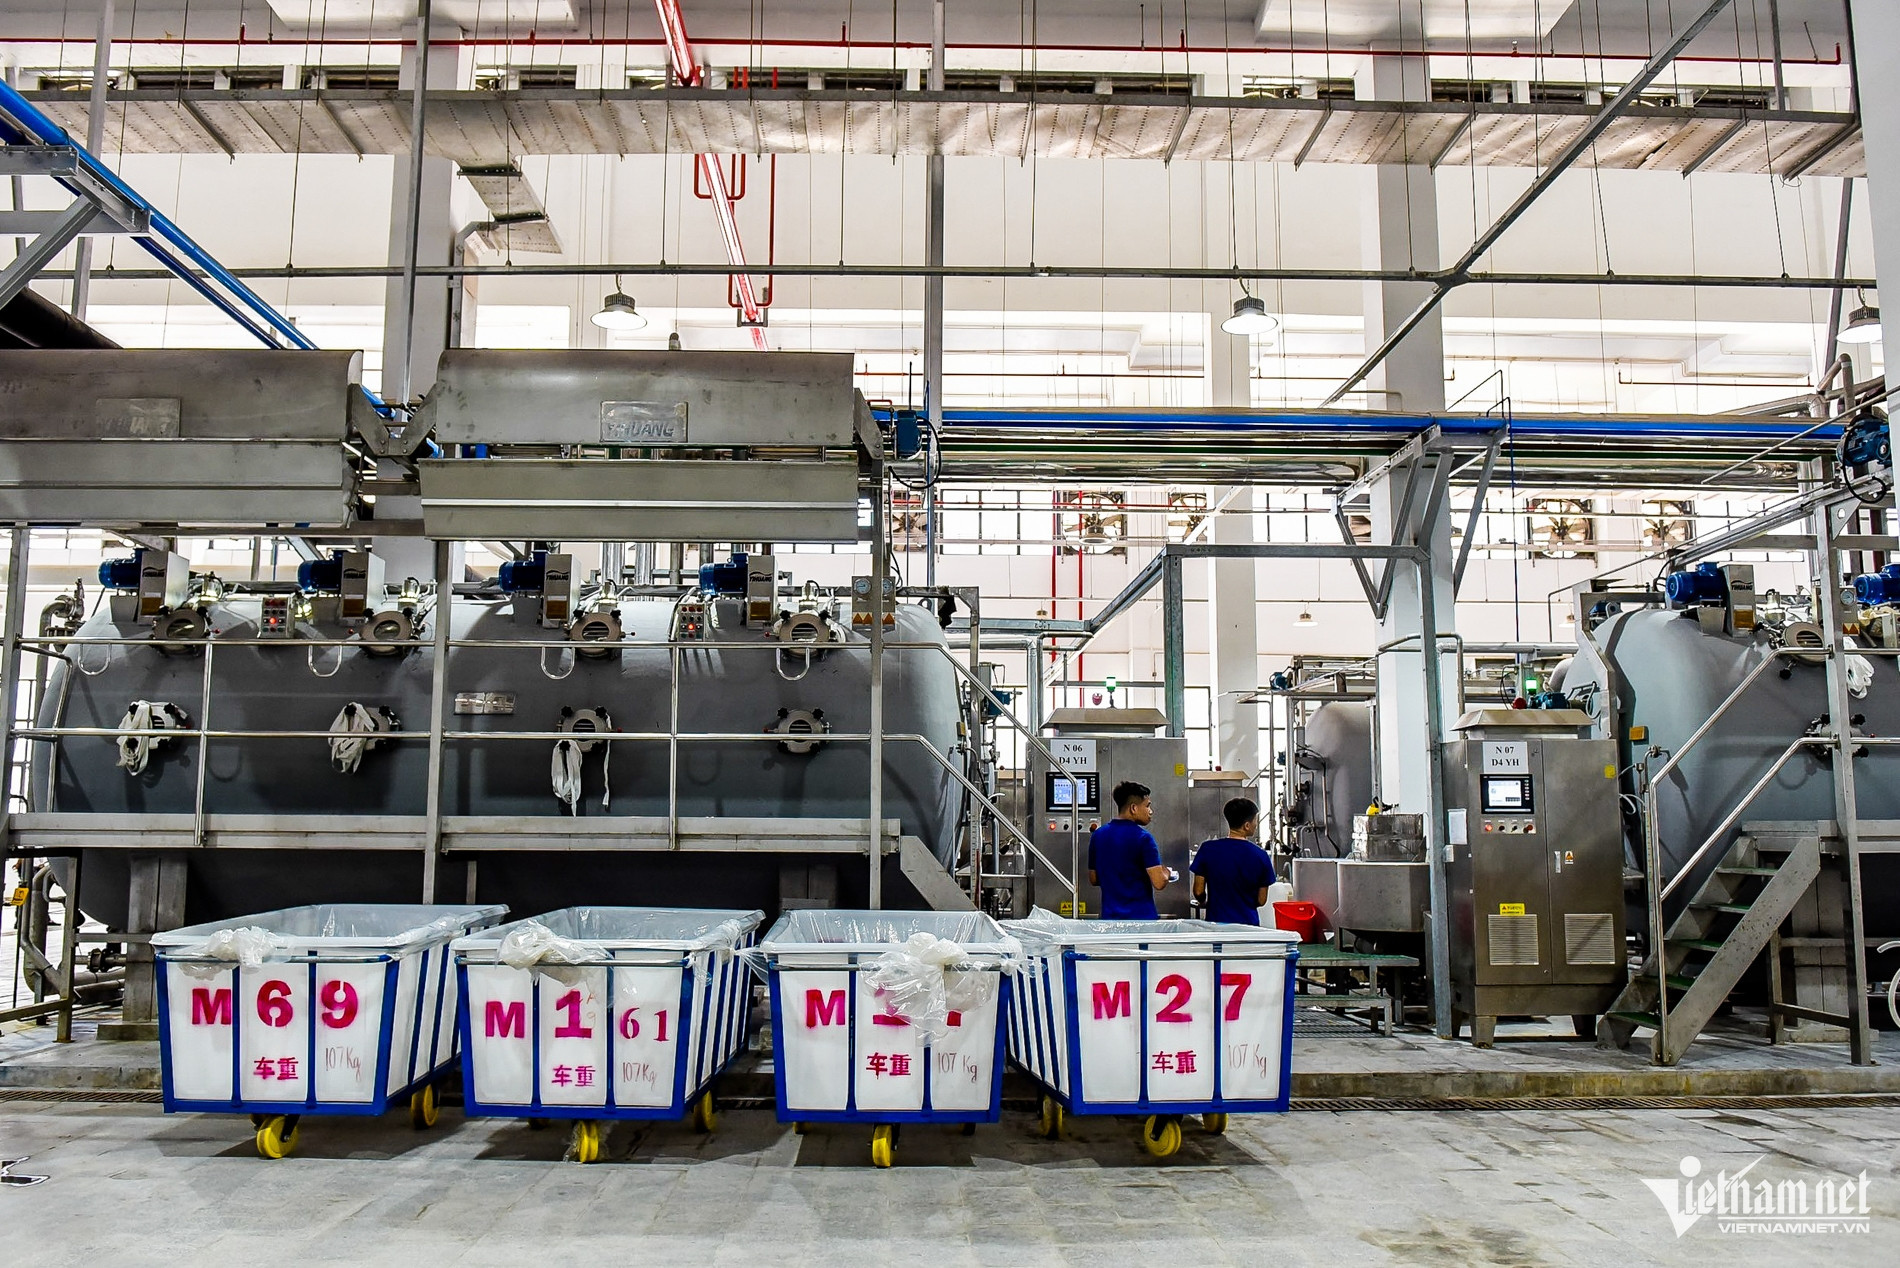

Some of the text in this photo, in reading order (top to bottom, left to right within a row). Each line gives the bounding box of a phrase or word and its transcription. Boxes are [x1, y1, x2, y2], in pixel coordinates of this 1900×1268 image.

[1059, 756, 1087, 765] D4 YH
[1063, 744, 1083, 752] N 06
[1495, 746, 1515, 754] N 07
[1491, 758, 1520, 766] D4 YH
[191, 987, 232, 1026] M
[805, 988, 846, 1029] M
[1091, 980, 1132, 1021] M
[485, 1000, 526, 1039] M
[252, 1056, 300, 1081] 车重
[865, 1051, 912, 1080] 车重
[1151, 1050, 1198, 1074] 车重
[551, 1063, 596, 1088] 车重
